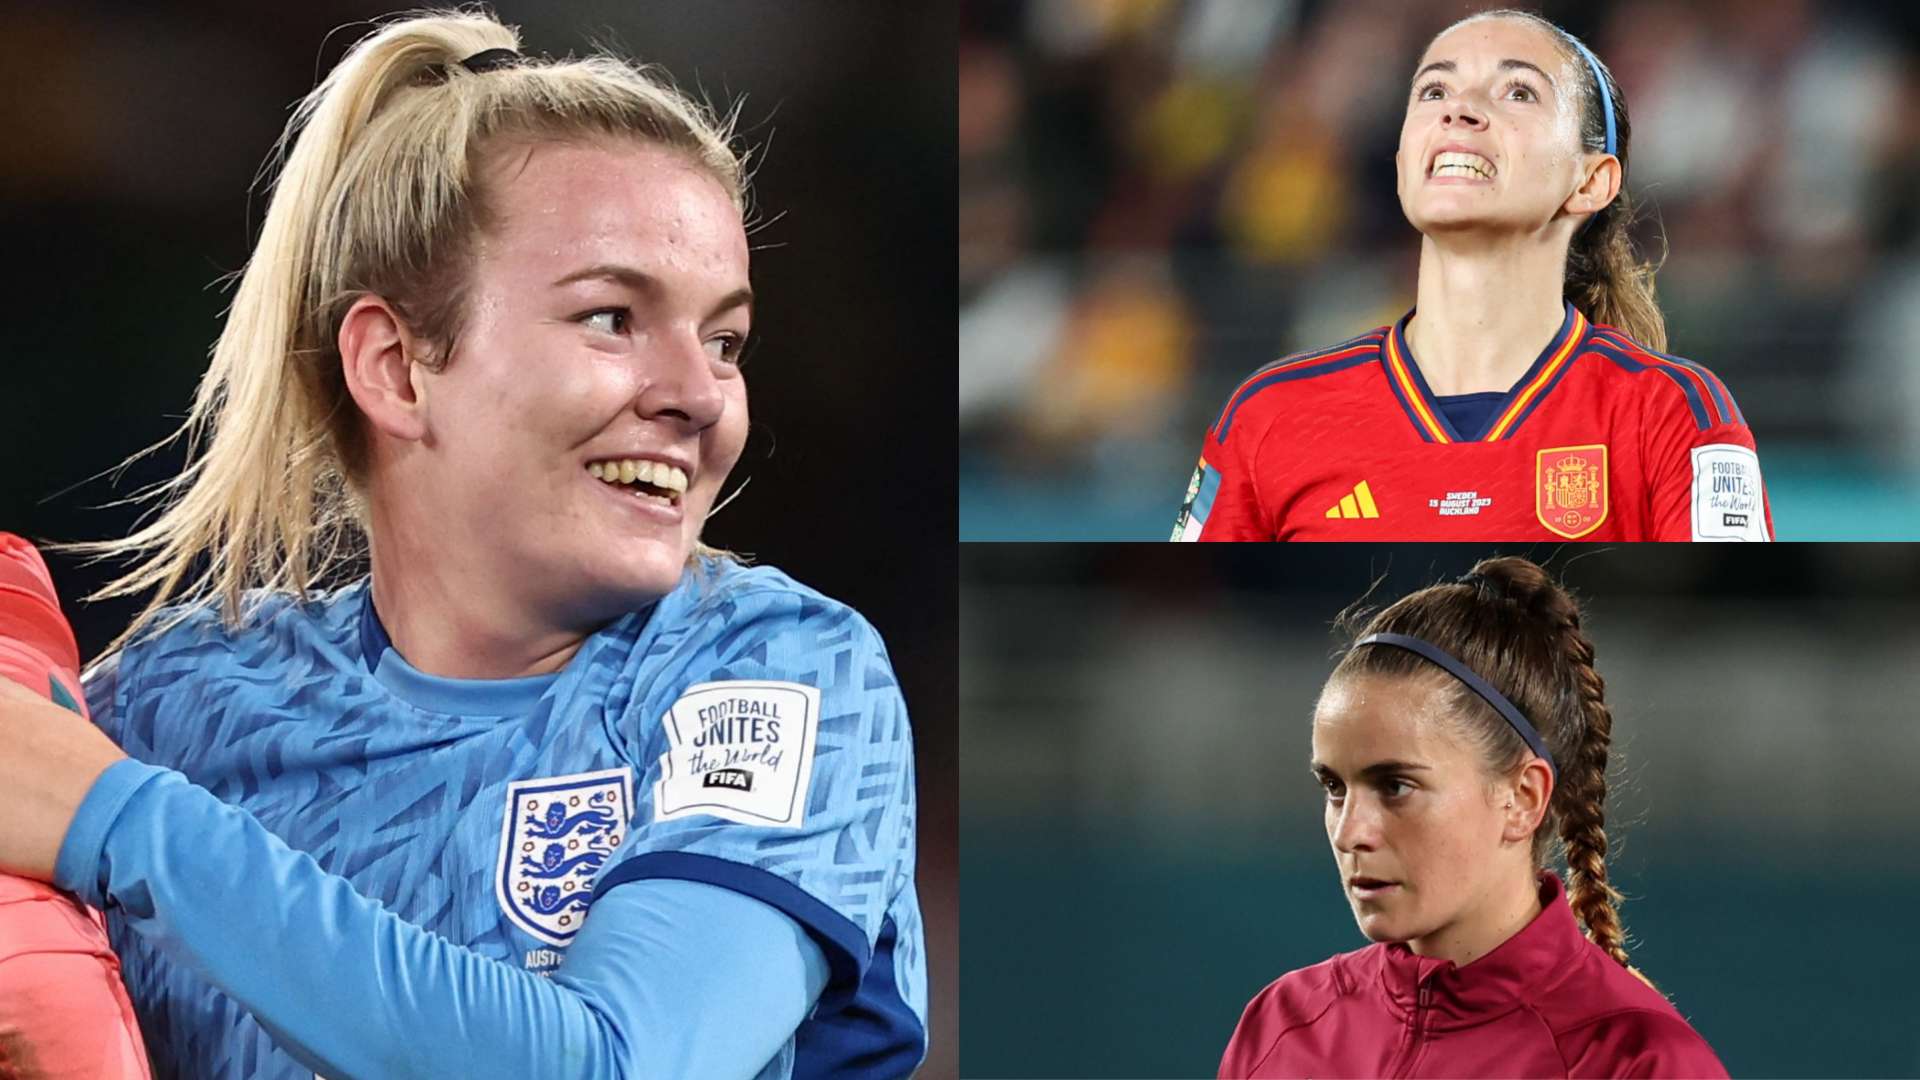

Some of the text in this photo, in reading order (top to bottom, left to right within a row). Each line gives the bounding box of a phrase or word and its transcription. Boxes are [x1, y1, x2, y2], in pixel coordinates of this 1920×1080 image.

[1446, 491, 1477, 500] SWEDEN
[1711, 494, 1728, 508] the
[1428, 499, 1439, 507] 15
[1440, 499, 1469, 508] AUGUST
[1725, 517, 1747, 526] FIFA
[688, 744, 784, 775] the World
[708, 771, 748, 787] FIFA
